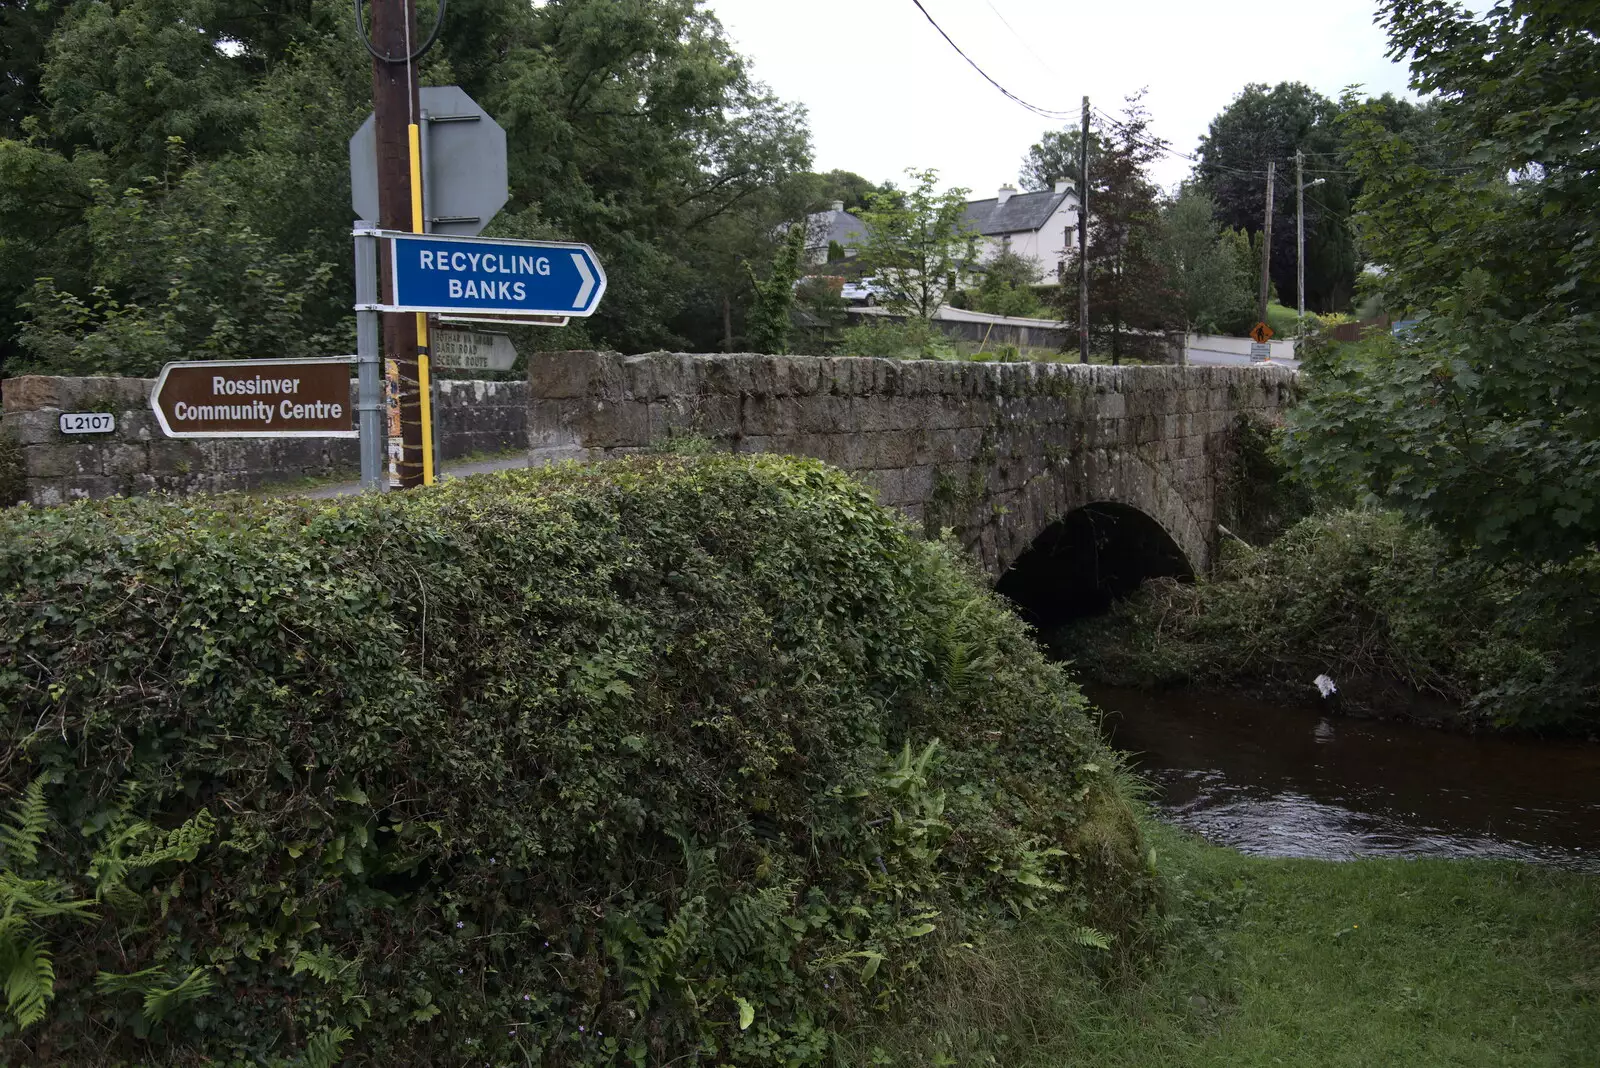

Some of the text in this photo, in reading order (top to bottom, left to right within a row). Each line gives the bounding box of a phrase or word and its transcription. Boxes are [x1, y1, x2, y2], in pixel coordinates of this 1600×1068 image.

[420, 250, 550, 276] RECYCLING
[448, 279, 526, 301] BANKS
[436, 342, 477, 355] BARR ROAD
[436, 354, 488, 368] SCENIC ROUTE
[212, 375, 300, 395] Rossinver
[174, 400, 342, 424] Community Centre
[64, 416, 110, 430] L2107
